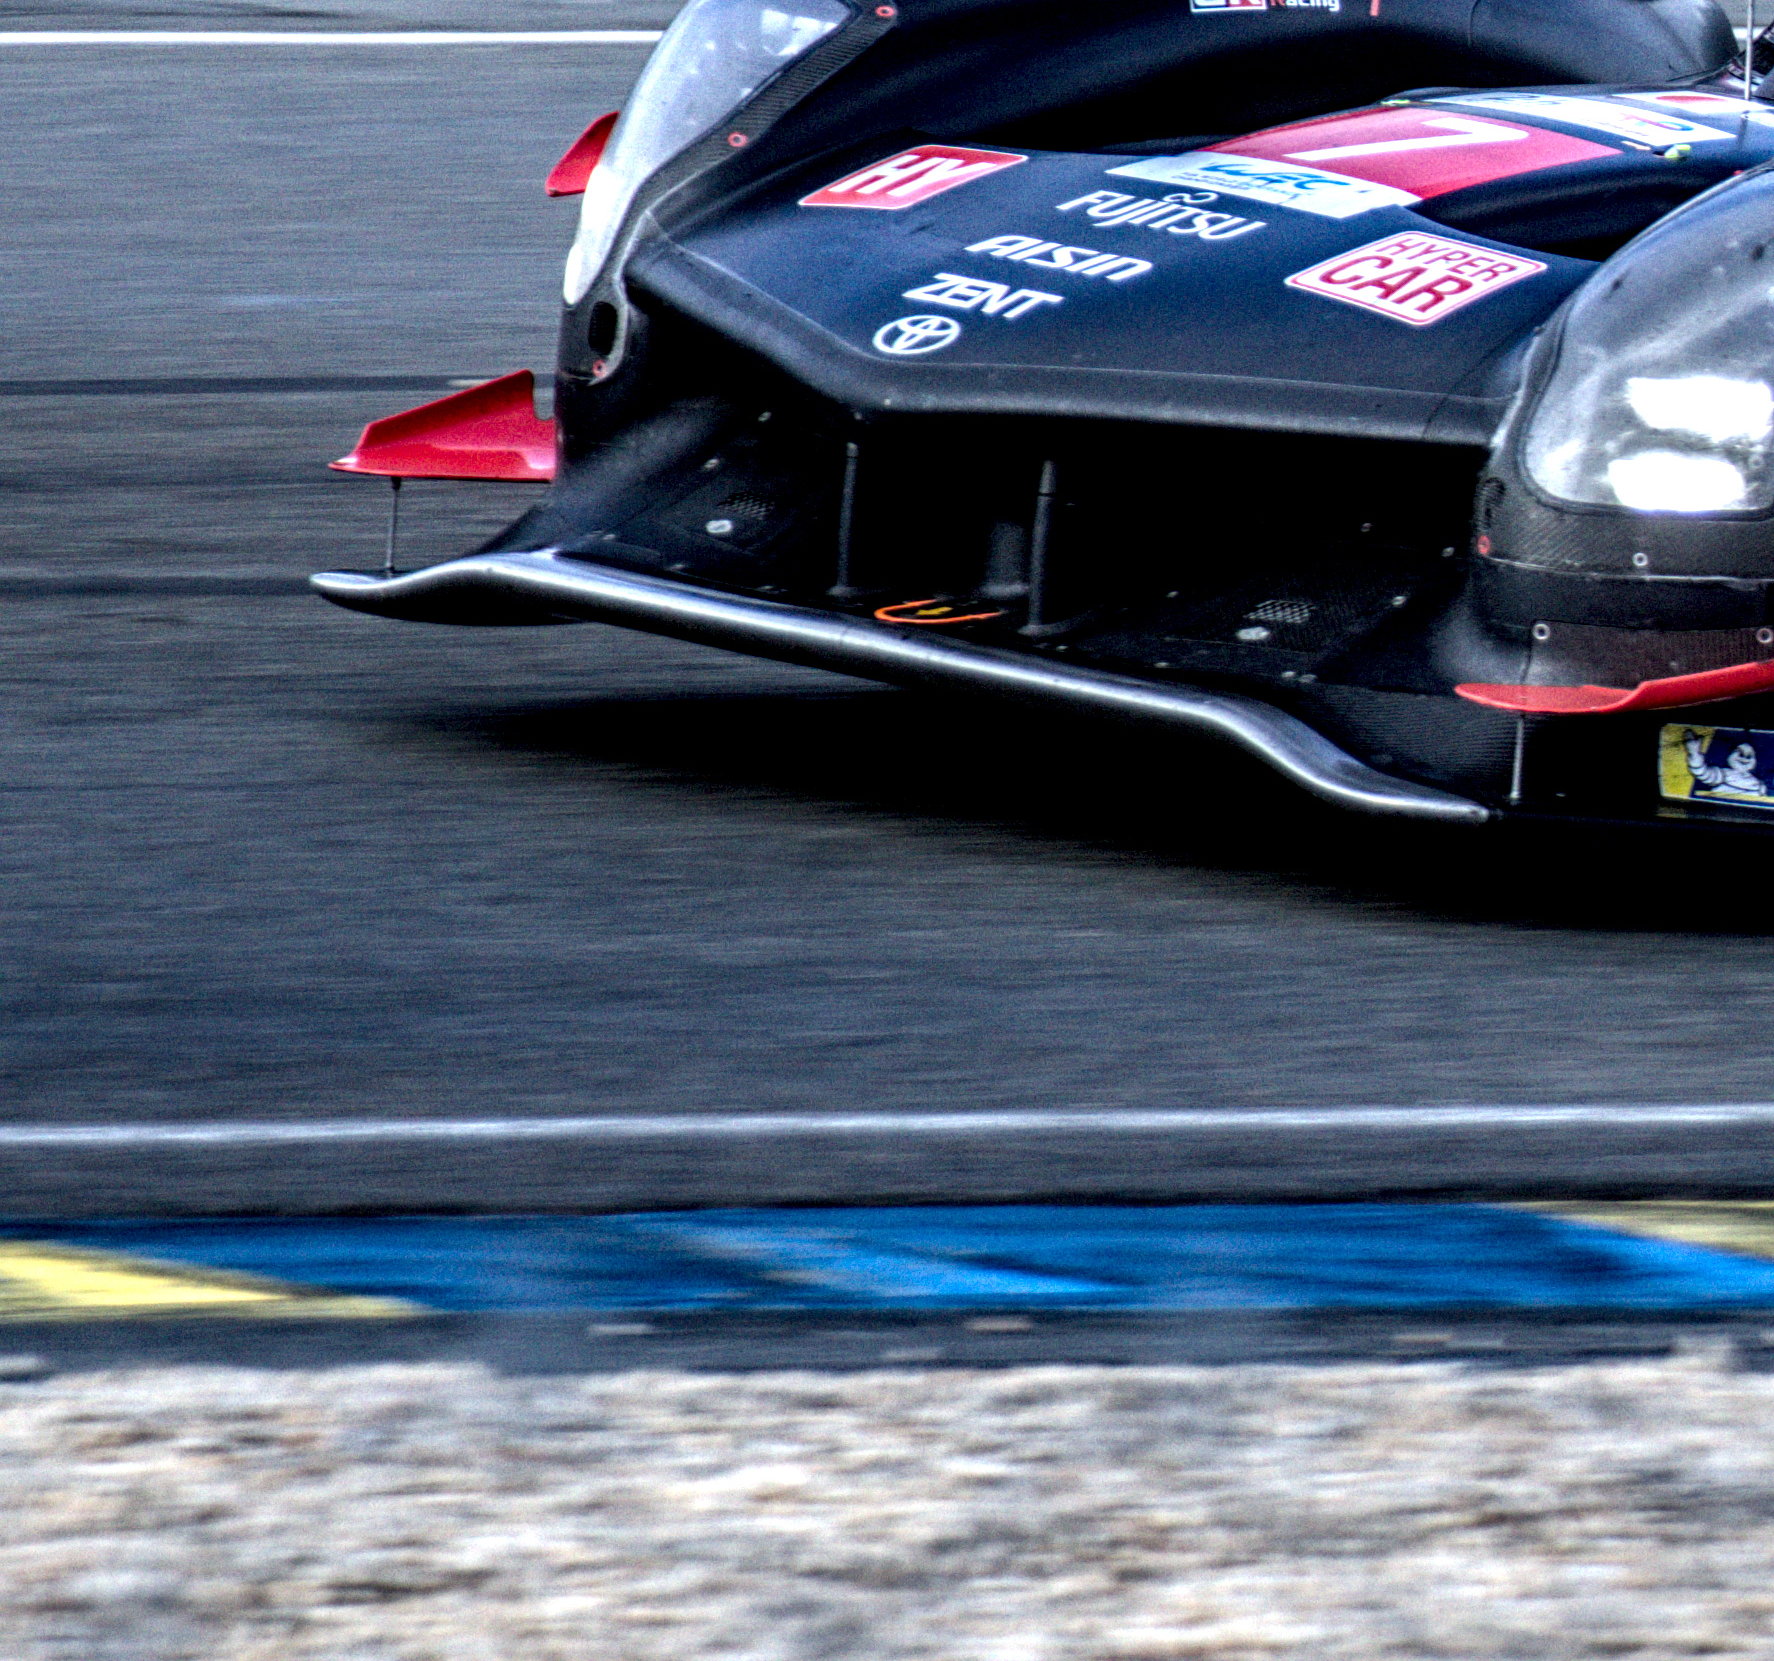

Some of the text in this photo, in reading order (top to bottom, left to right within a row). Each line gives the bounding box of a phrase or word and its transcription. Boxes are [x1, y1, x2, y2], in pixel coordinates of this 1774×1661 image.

[1283, 116, 1530, 162] 7
[828, 153, 1000, 197] HY
[1056, 189, 1268, 240] FUJITSU
[964, 235, 1154, 281] AISIN
[1385, 237, 1519, 283] HYPER
[902, 272, 1066, 319] ZENT
[1318, 255, 1474, 313] CAR
